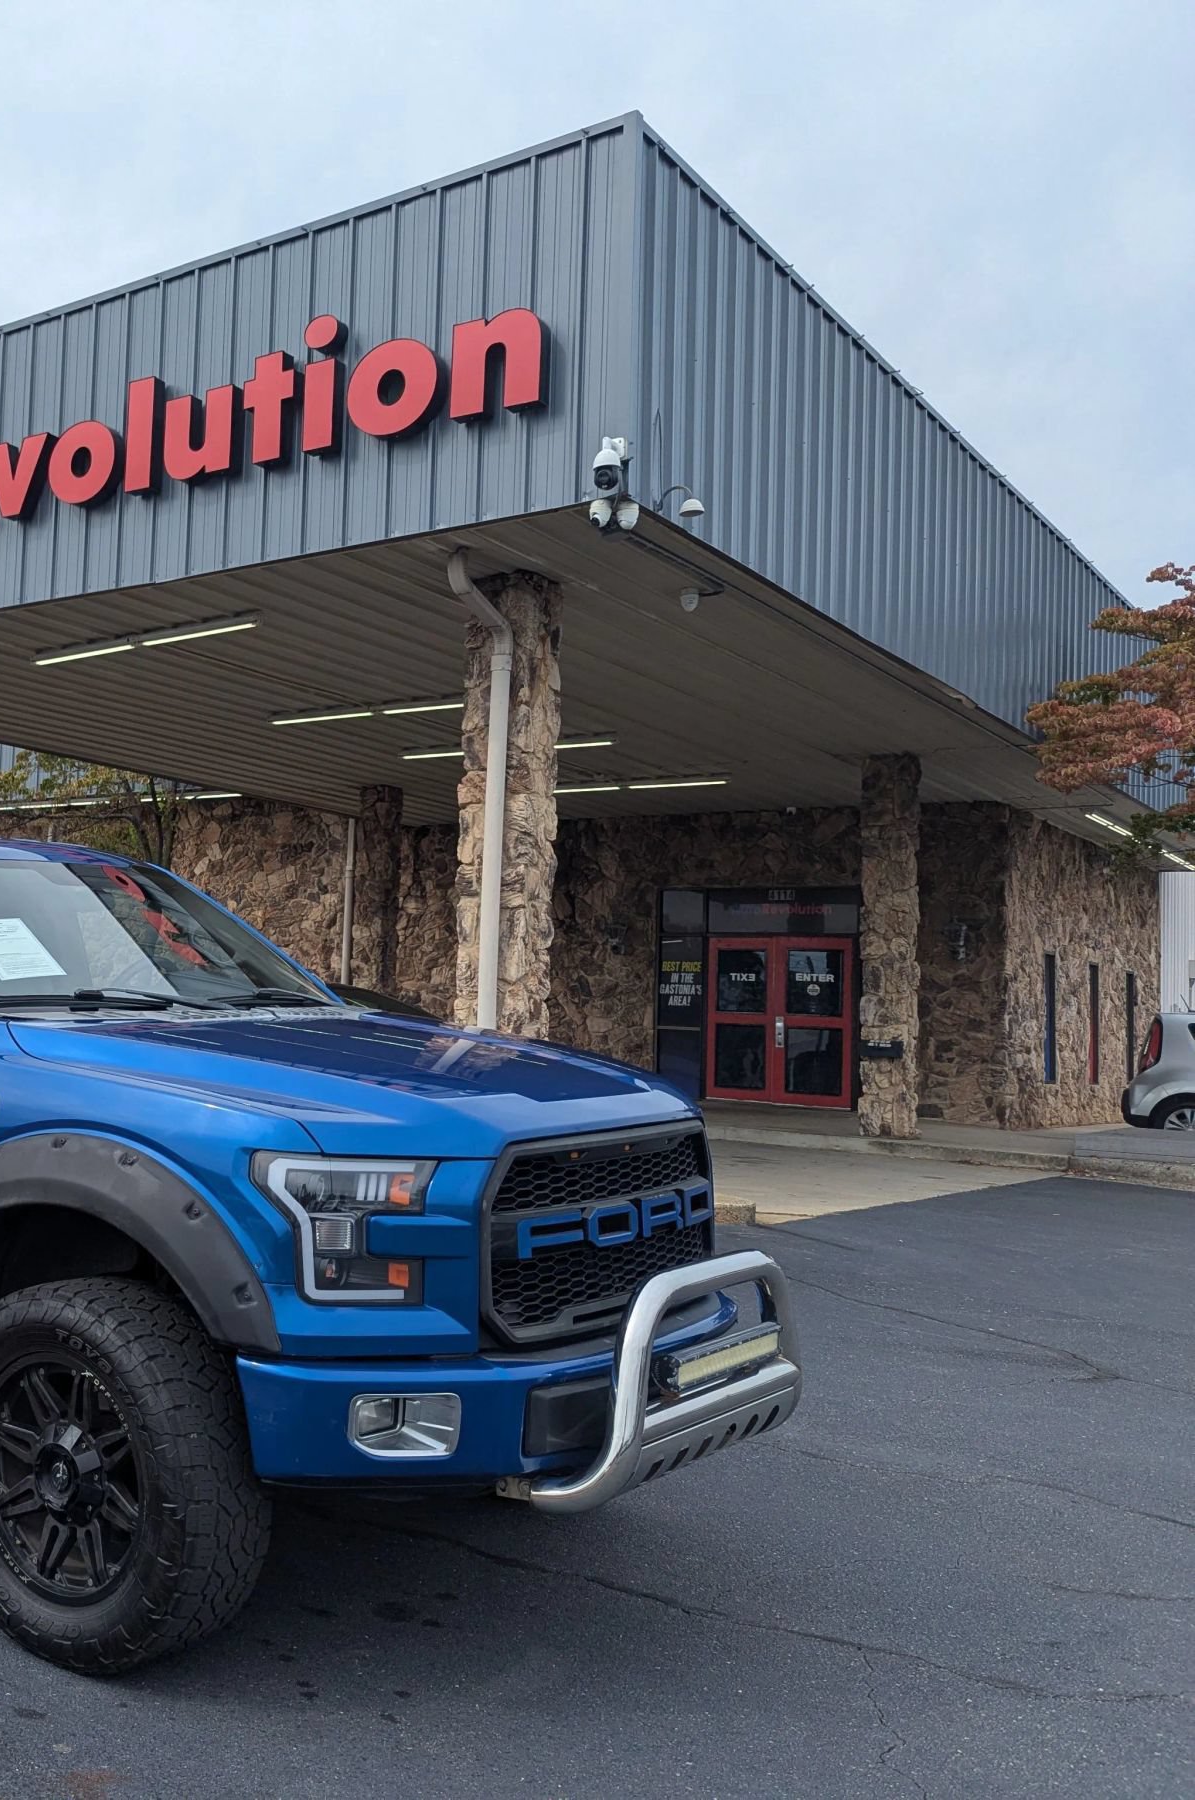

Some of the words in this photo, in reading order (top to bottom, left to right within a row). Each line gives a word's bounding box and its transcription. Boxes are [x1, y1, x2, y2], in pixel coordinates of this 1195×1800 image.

[661, 961, 681, 972] BEST
[681, 961, 703, 973] PRICE
[670, 972, 679, 983] IN
[680, 972, 695, 983] THE
[795, 972, 835, 983] ENTER
[659, 983, 703, 996] GASTONIA'S
[667, 995, 692, 1007] AREA!
[516, 1181, 714, 1261] FORD
[55, 1327, 113, 1375] TOYO
